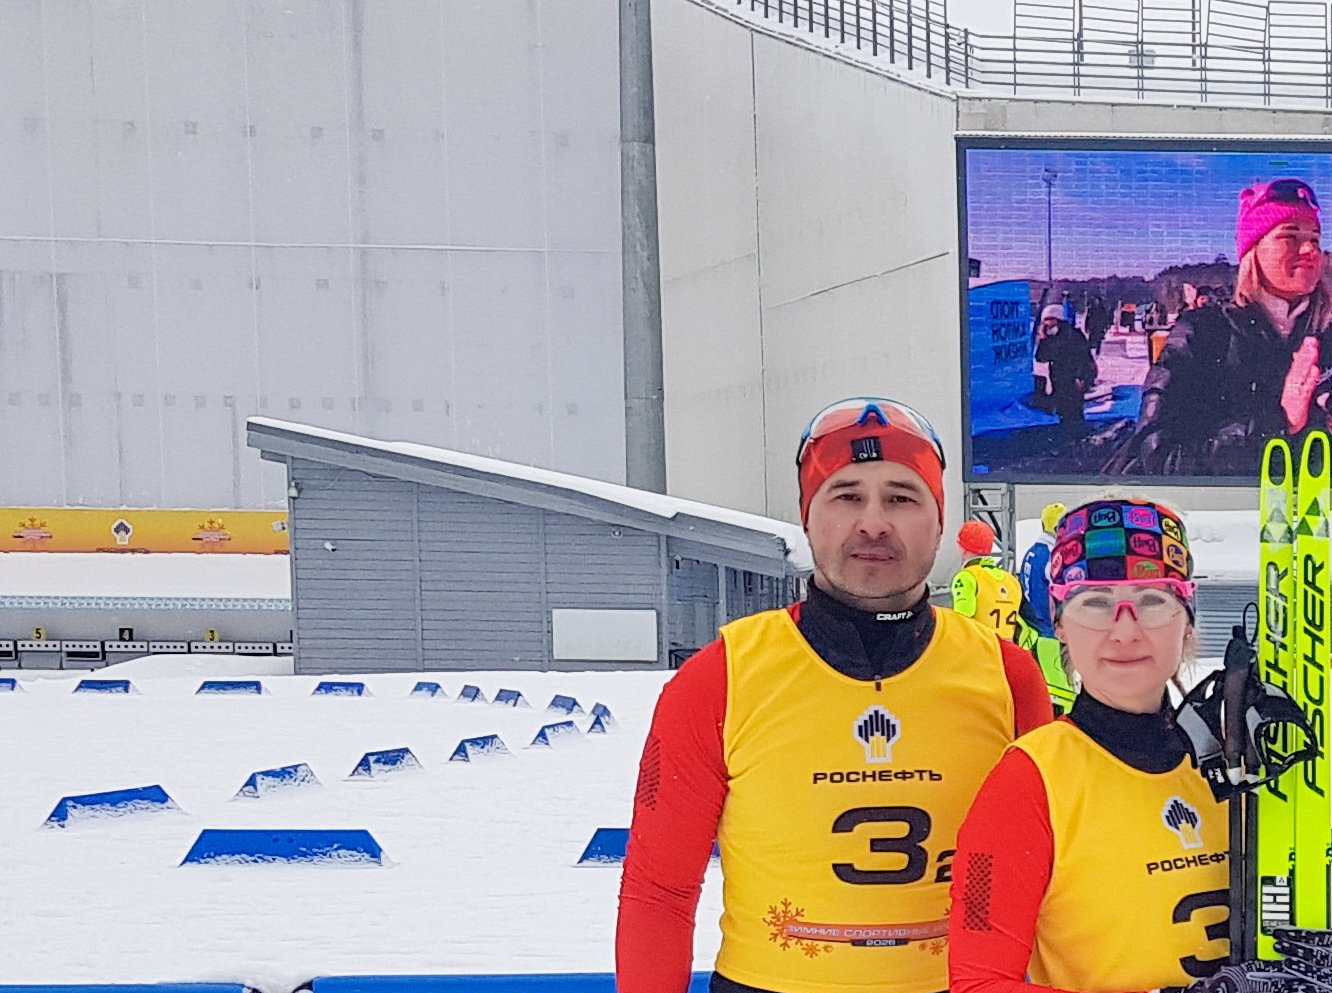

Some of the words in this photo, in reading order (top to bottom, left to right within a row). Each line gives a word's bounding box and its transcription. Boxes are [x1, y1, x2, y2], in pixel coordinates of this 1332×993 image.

[876, 612, 907, 621] CRAFT
[989, 608, 1017, 629] 14
[34, 628, 42, 640] 5
[123, 630, 130, 641] 4
[208, 630, 215, 641] 3
[812, 769, 943, 785] РОСНЕФТЬ
[831, 805, 932, 886] 3
[786, 925, 840, 936] ЗИМНИЕ
